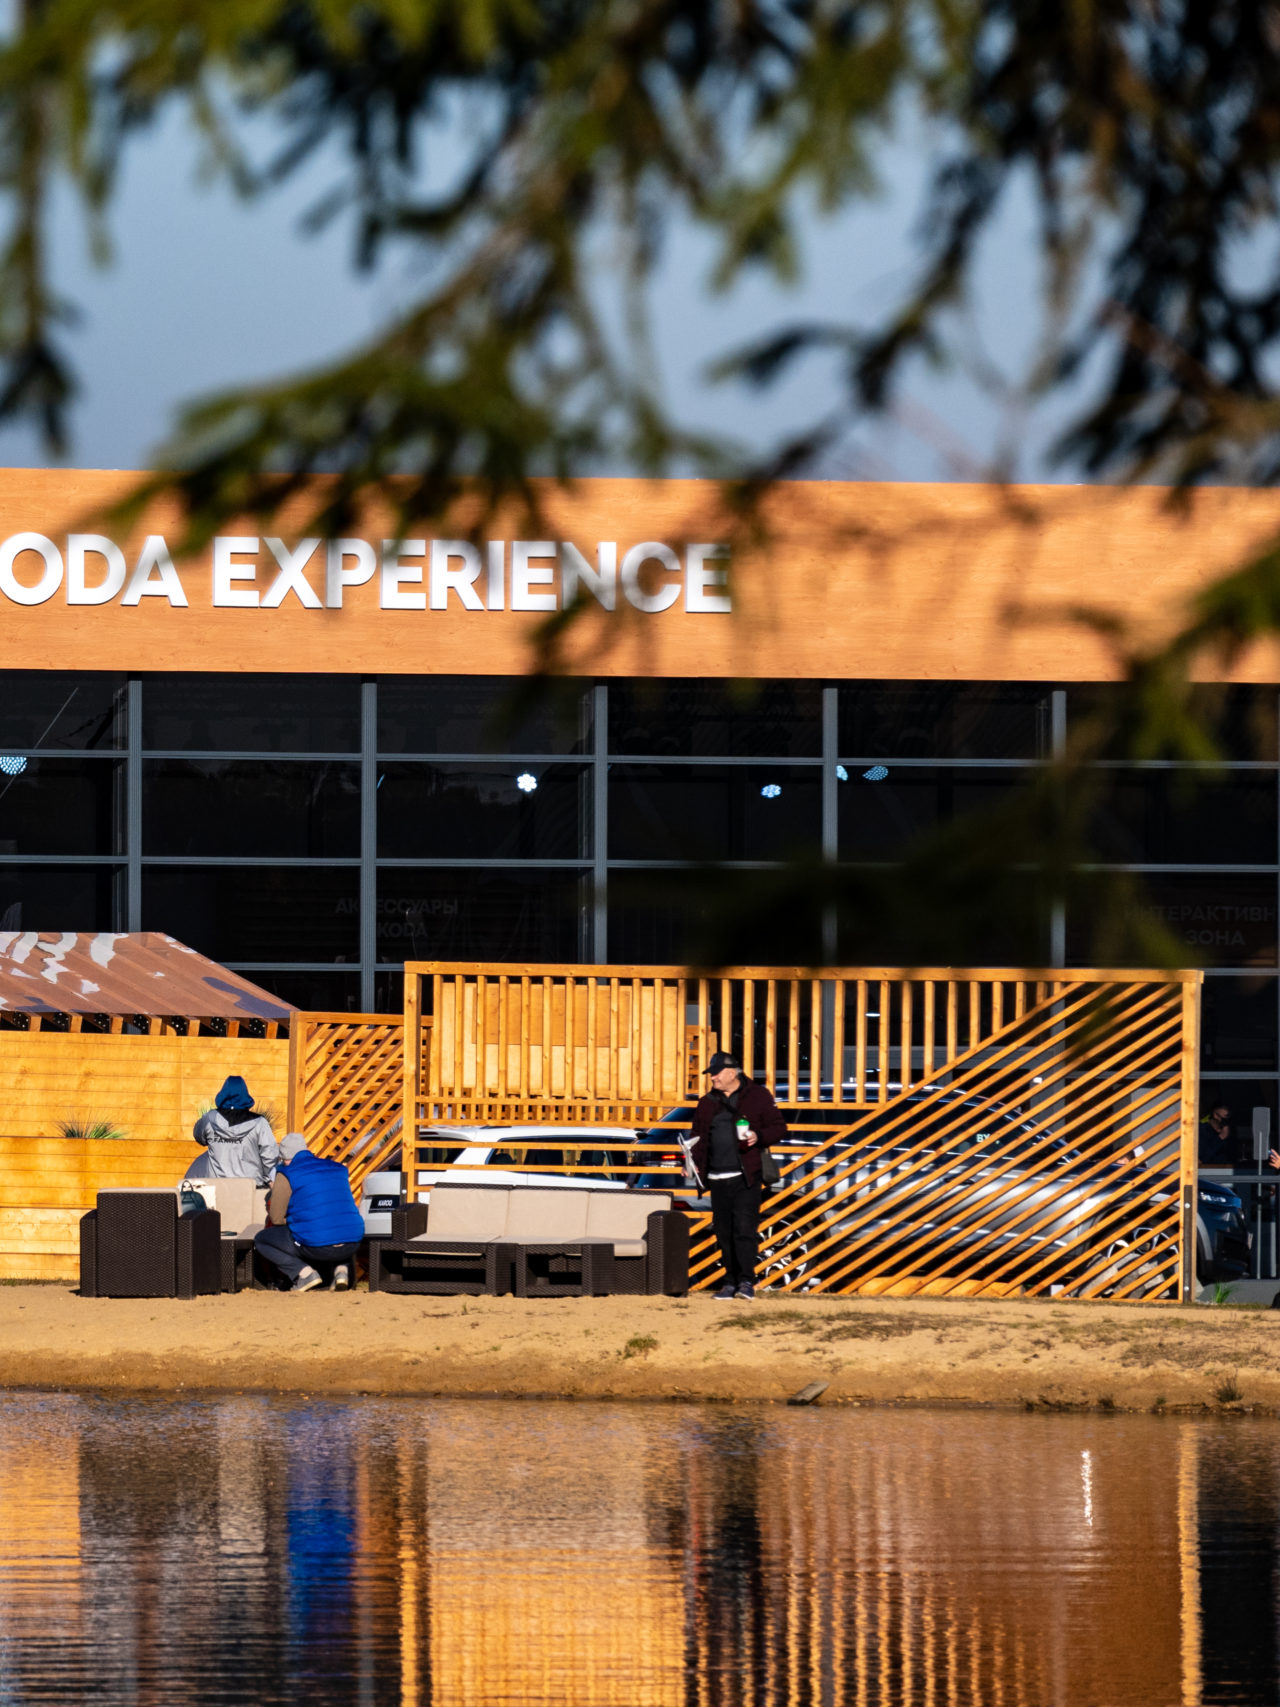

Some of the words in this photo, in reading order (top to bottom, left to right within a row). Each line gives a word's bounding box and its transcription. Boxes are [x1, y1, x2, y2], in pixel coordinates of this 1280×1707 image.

[212, 535, 732, 614] EXPERIENCE
[376, 921, 429, 938] KODA
[1185, 929, 1246, 946] ЗОНА
